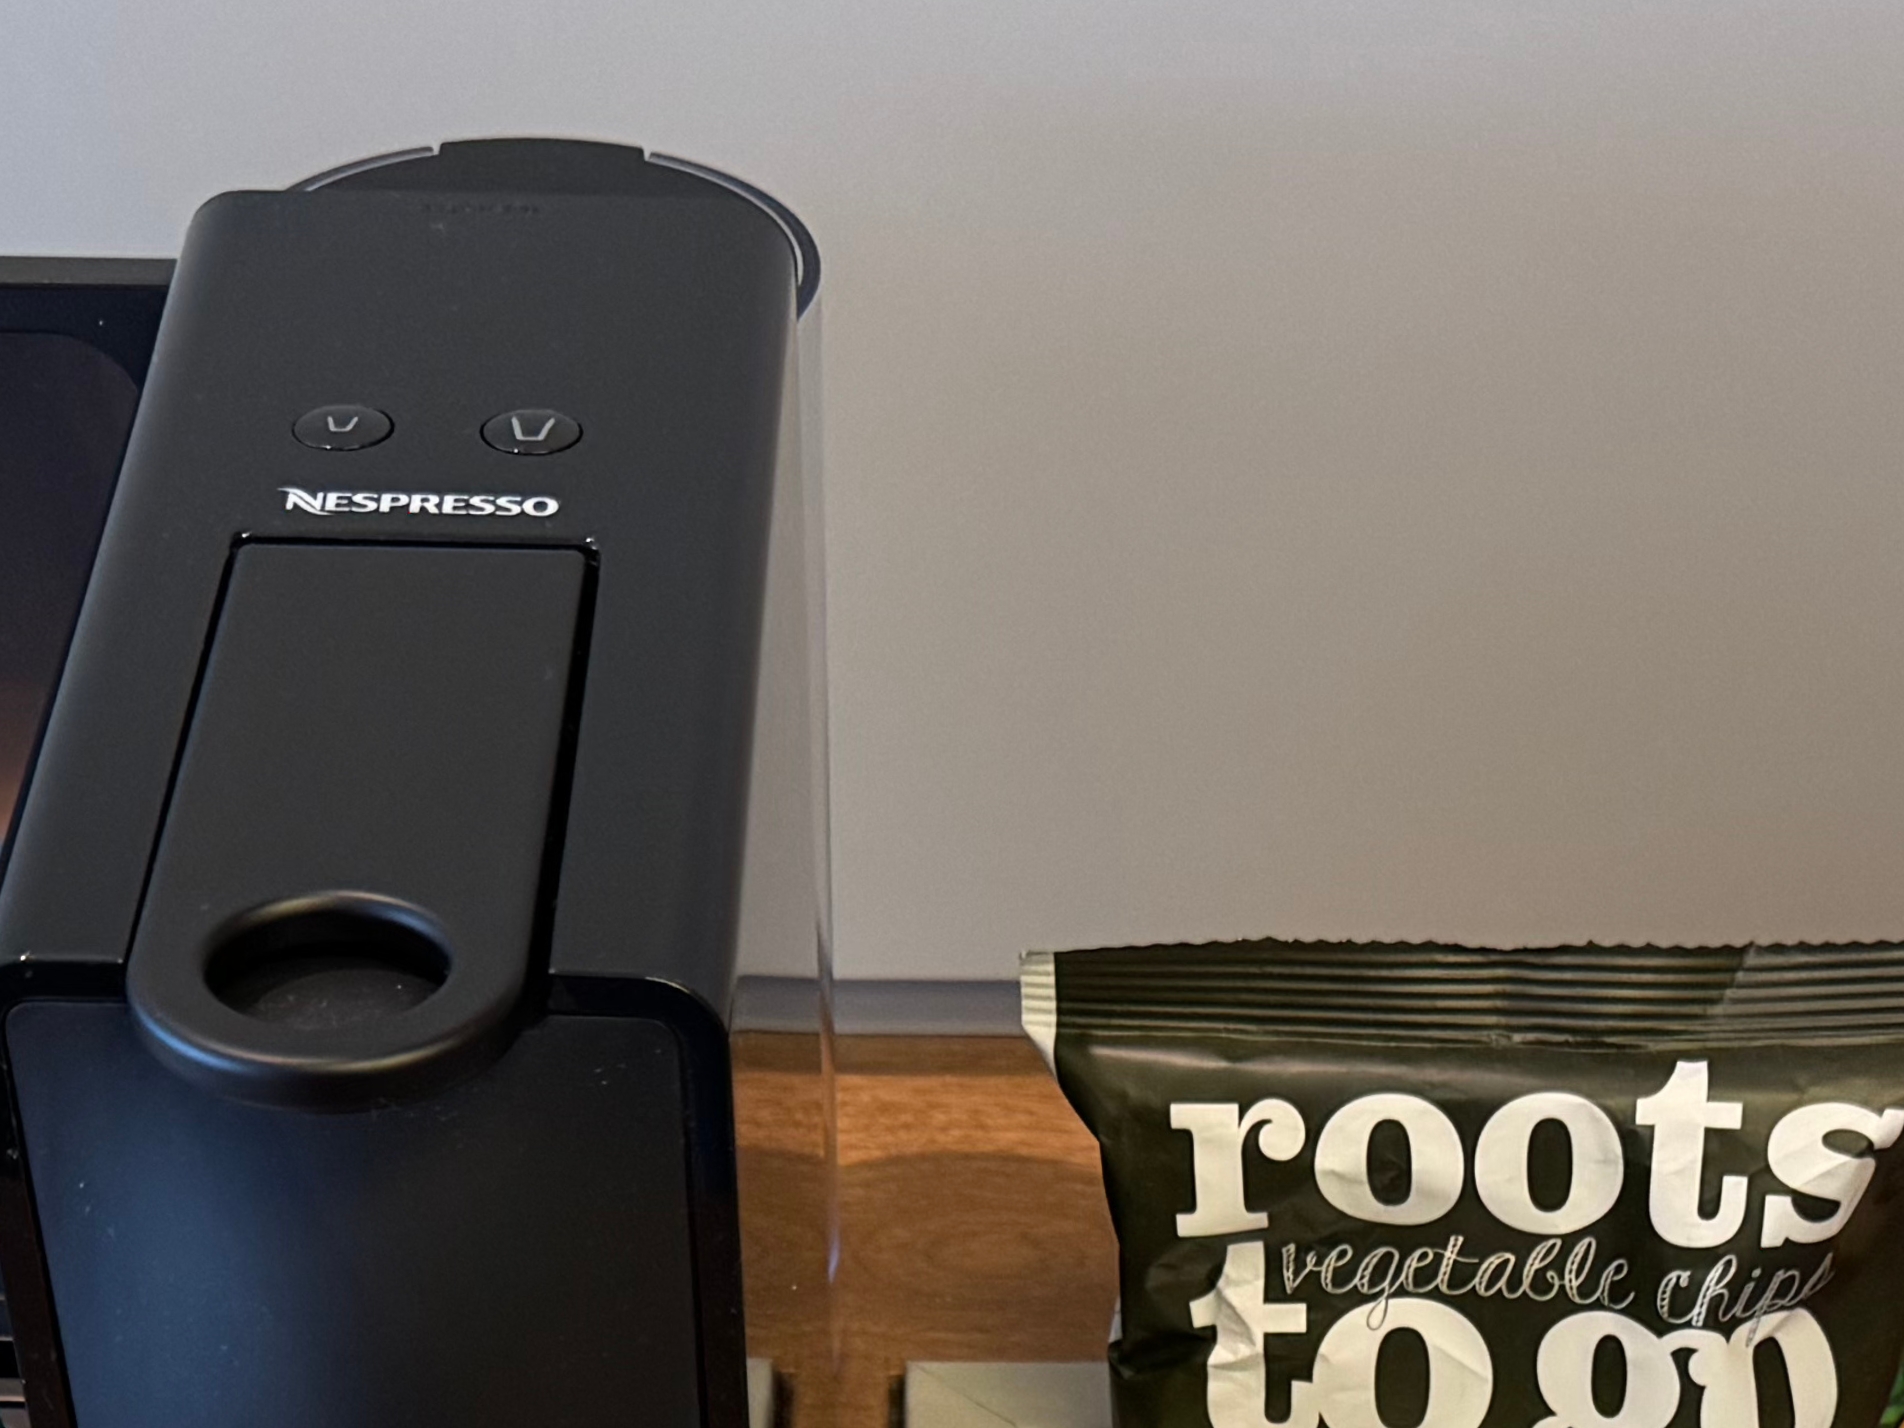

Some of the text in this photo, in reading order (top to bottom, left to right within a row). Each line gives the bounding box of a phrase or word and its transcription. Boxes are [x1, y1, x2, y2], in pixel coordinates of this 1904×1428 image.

[277, 487, 560, 517] NESPRESSO
[1281, 1235, 1836, 1348] vegetable chips
